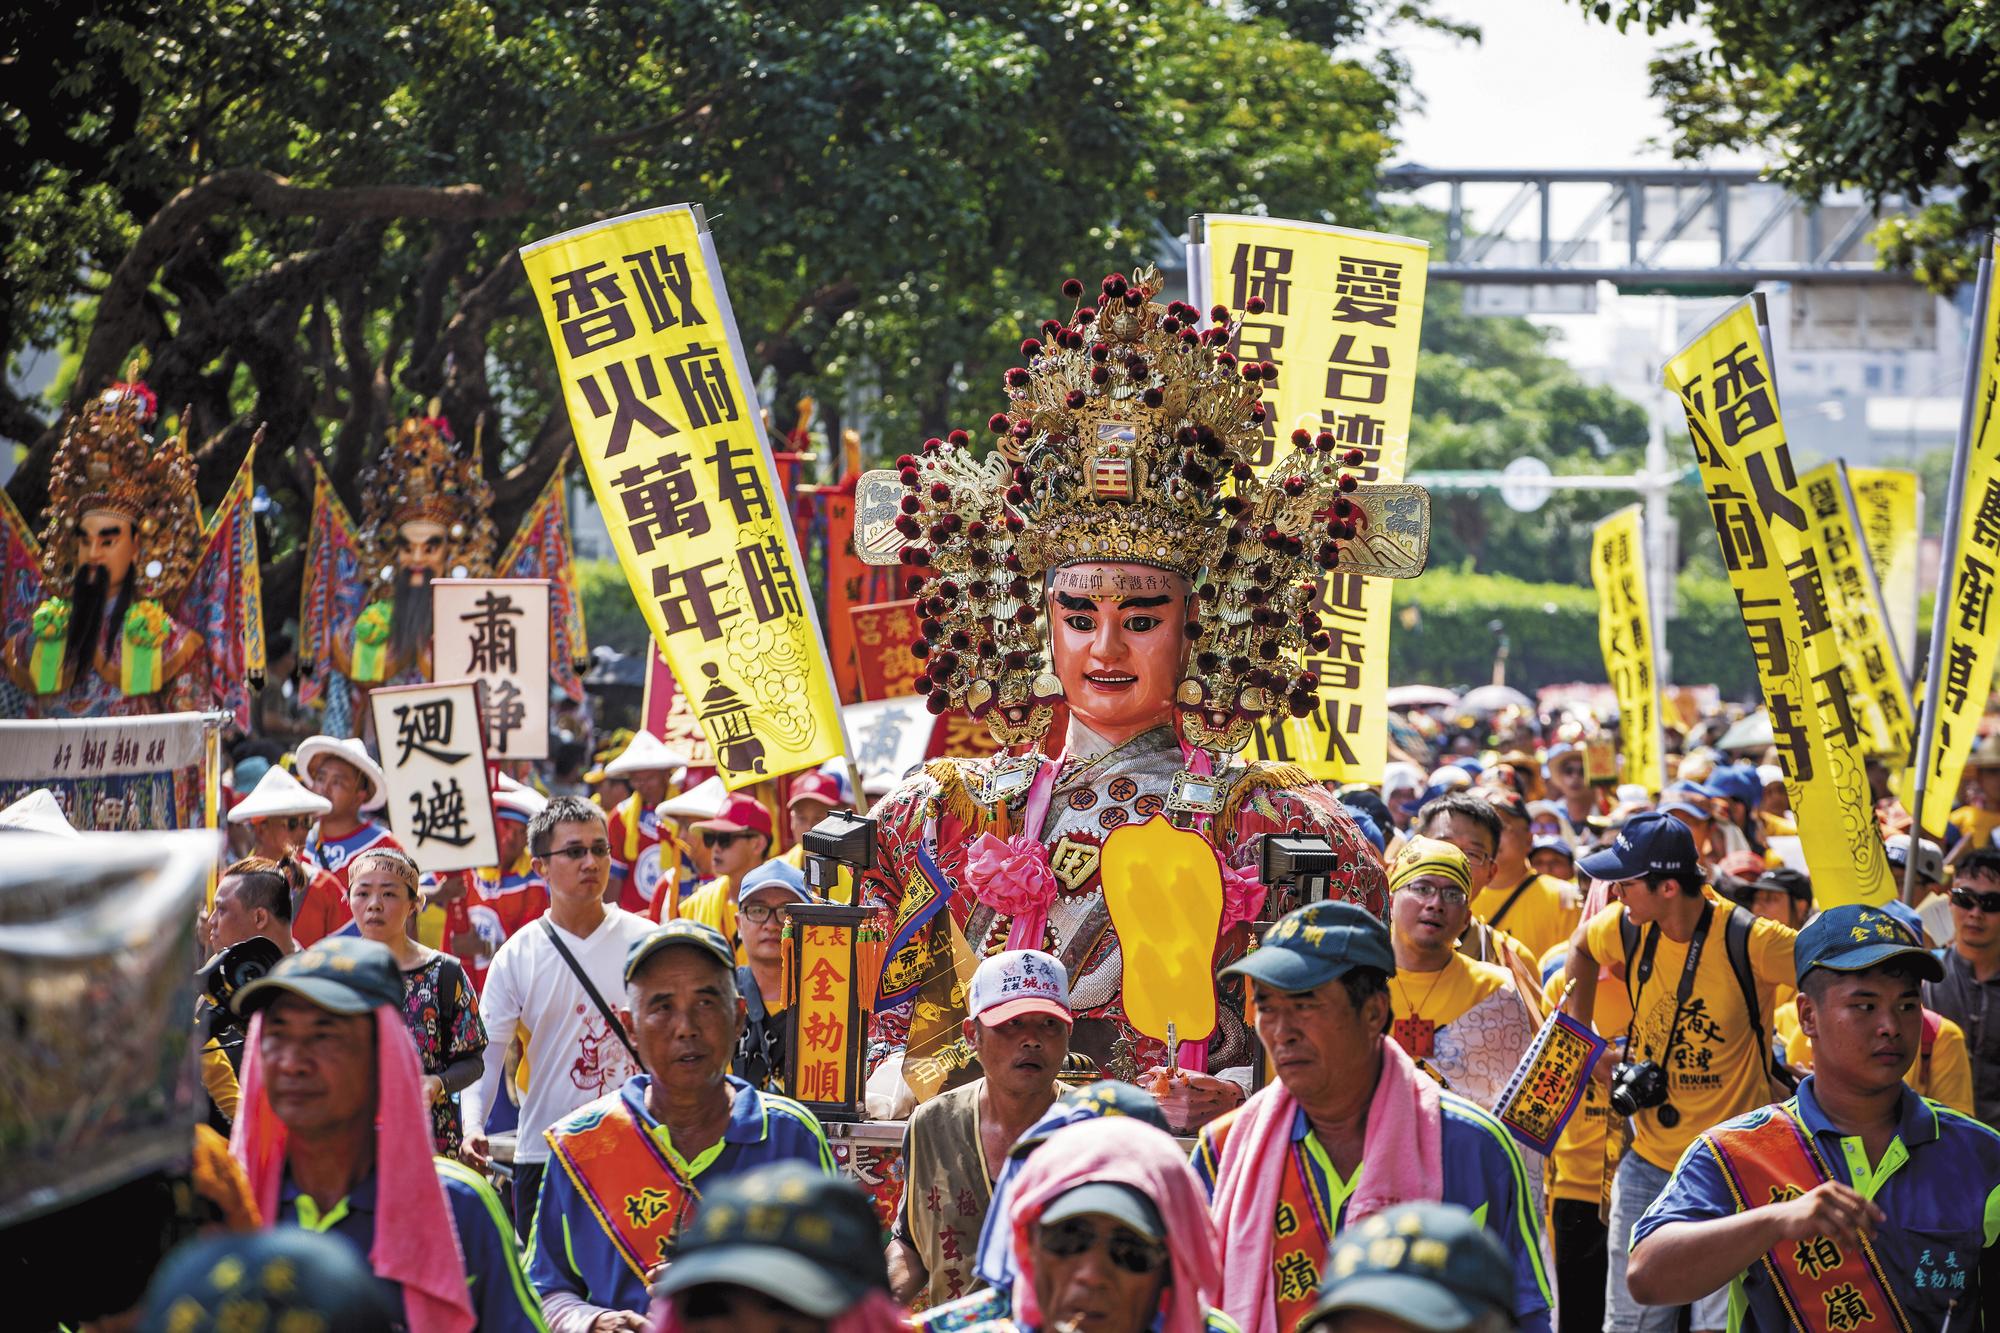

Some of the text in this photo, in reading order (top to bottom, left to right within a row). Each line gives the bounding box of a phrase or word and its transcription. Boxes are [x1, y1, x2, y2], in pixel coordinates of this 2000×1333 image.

[622, 244, 803, 624] 政府有時
[551, 260, 742, 643] 香火萬年
[1112, 574, 1171, 590] 守護香火
[927, 1185, 979, 1217] 北極
[1918, 1249, 1960, 1268] 元長
